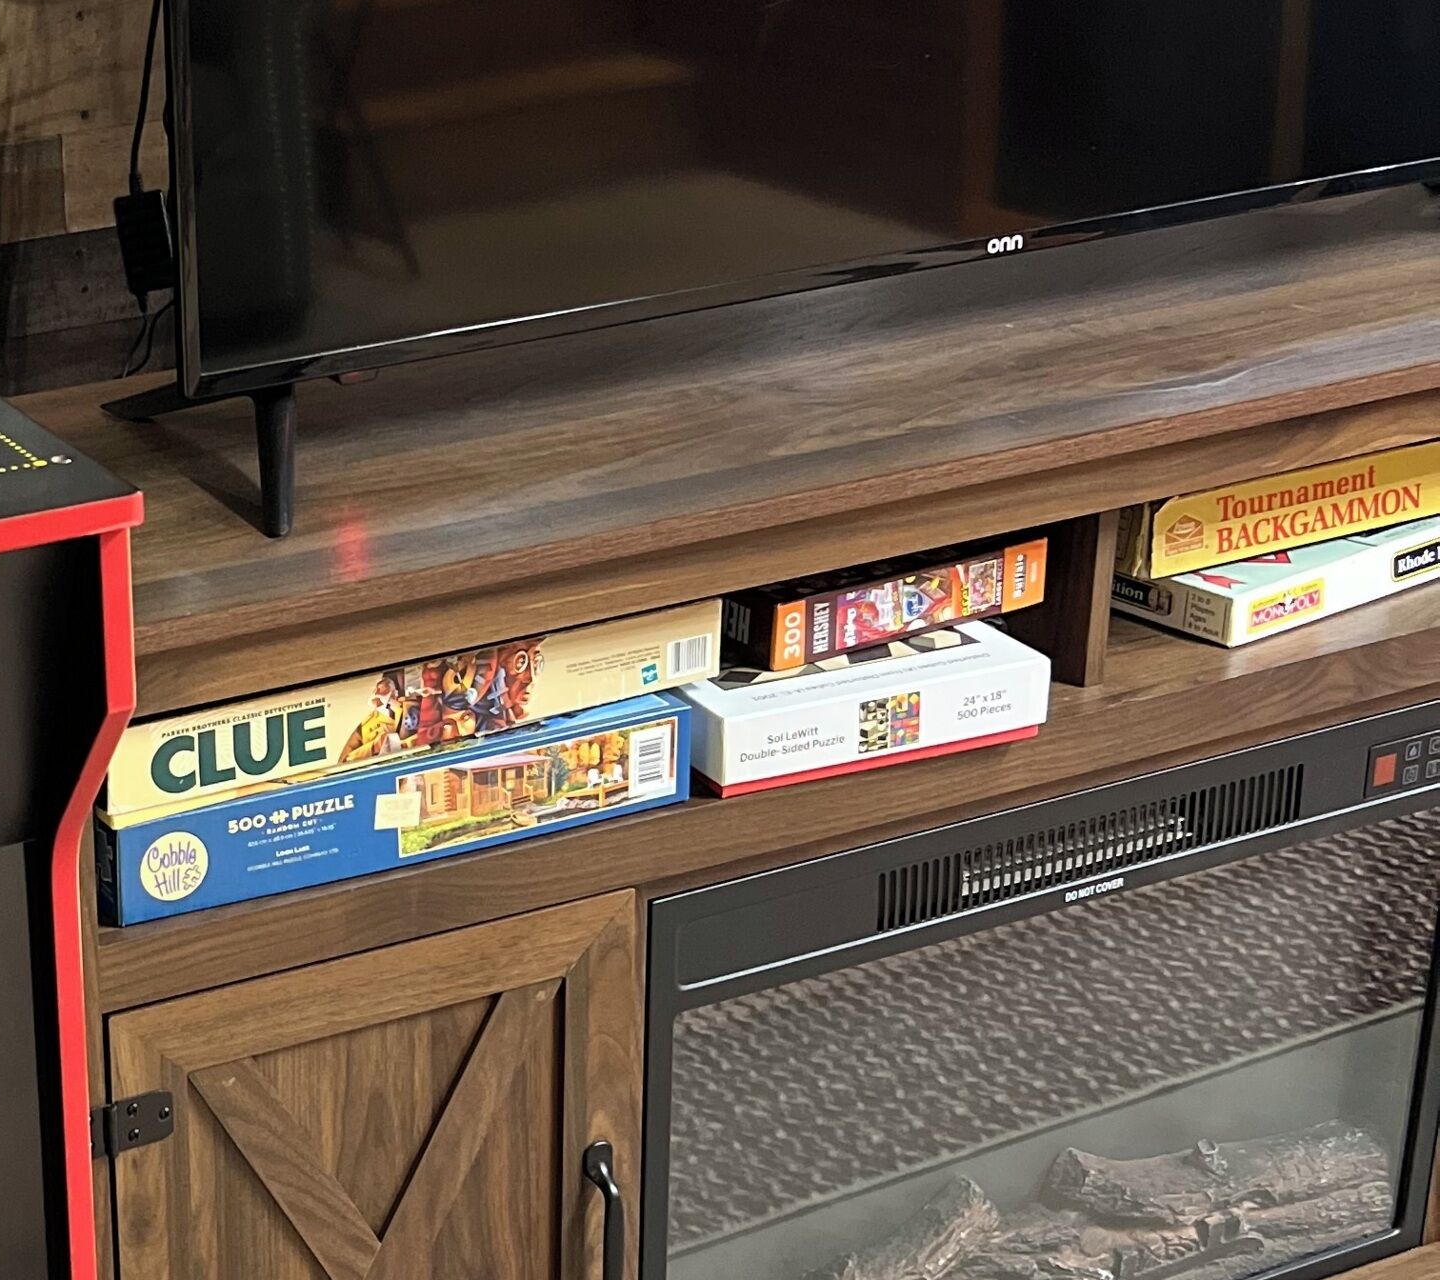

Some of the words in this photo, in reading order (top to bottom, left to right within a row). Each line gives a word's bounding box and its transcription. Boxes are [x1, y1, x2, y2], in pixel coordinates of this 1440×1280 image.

[1216, 465, 1376, 522] Tournament
[1216, 483, 1422, 554] BACKGAMMON
[1397, 548, 1435, 574] Rhode
[784, 611, 802, 660] 300
[812, 601, 831, 655] HERSHEY
[957, 707, 978, 721] 500
[979, 701, 1012, 717] Pieces
[150, 705, 326, 794] CLUE
[740, 740, 811, 763] Double-Sided
[812, 734, 845, 750] Puzzle
[767, 731, 784, 745] Sol
[785, 726, 819, 742] LeWitt
[228, 813, 267, 834] 500
[292, 794, 355, 821] PUZZLE
[147, 840, 197, 873] Cobble
[154, 867, 181, 897] Hill
[1065, 890, 1078, 903] DO
[1078, 885, 1096, 899] NOT
[1095, 878, 1124, 893] COVER
